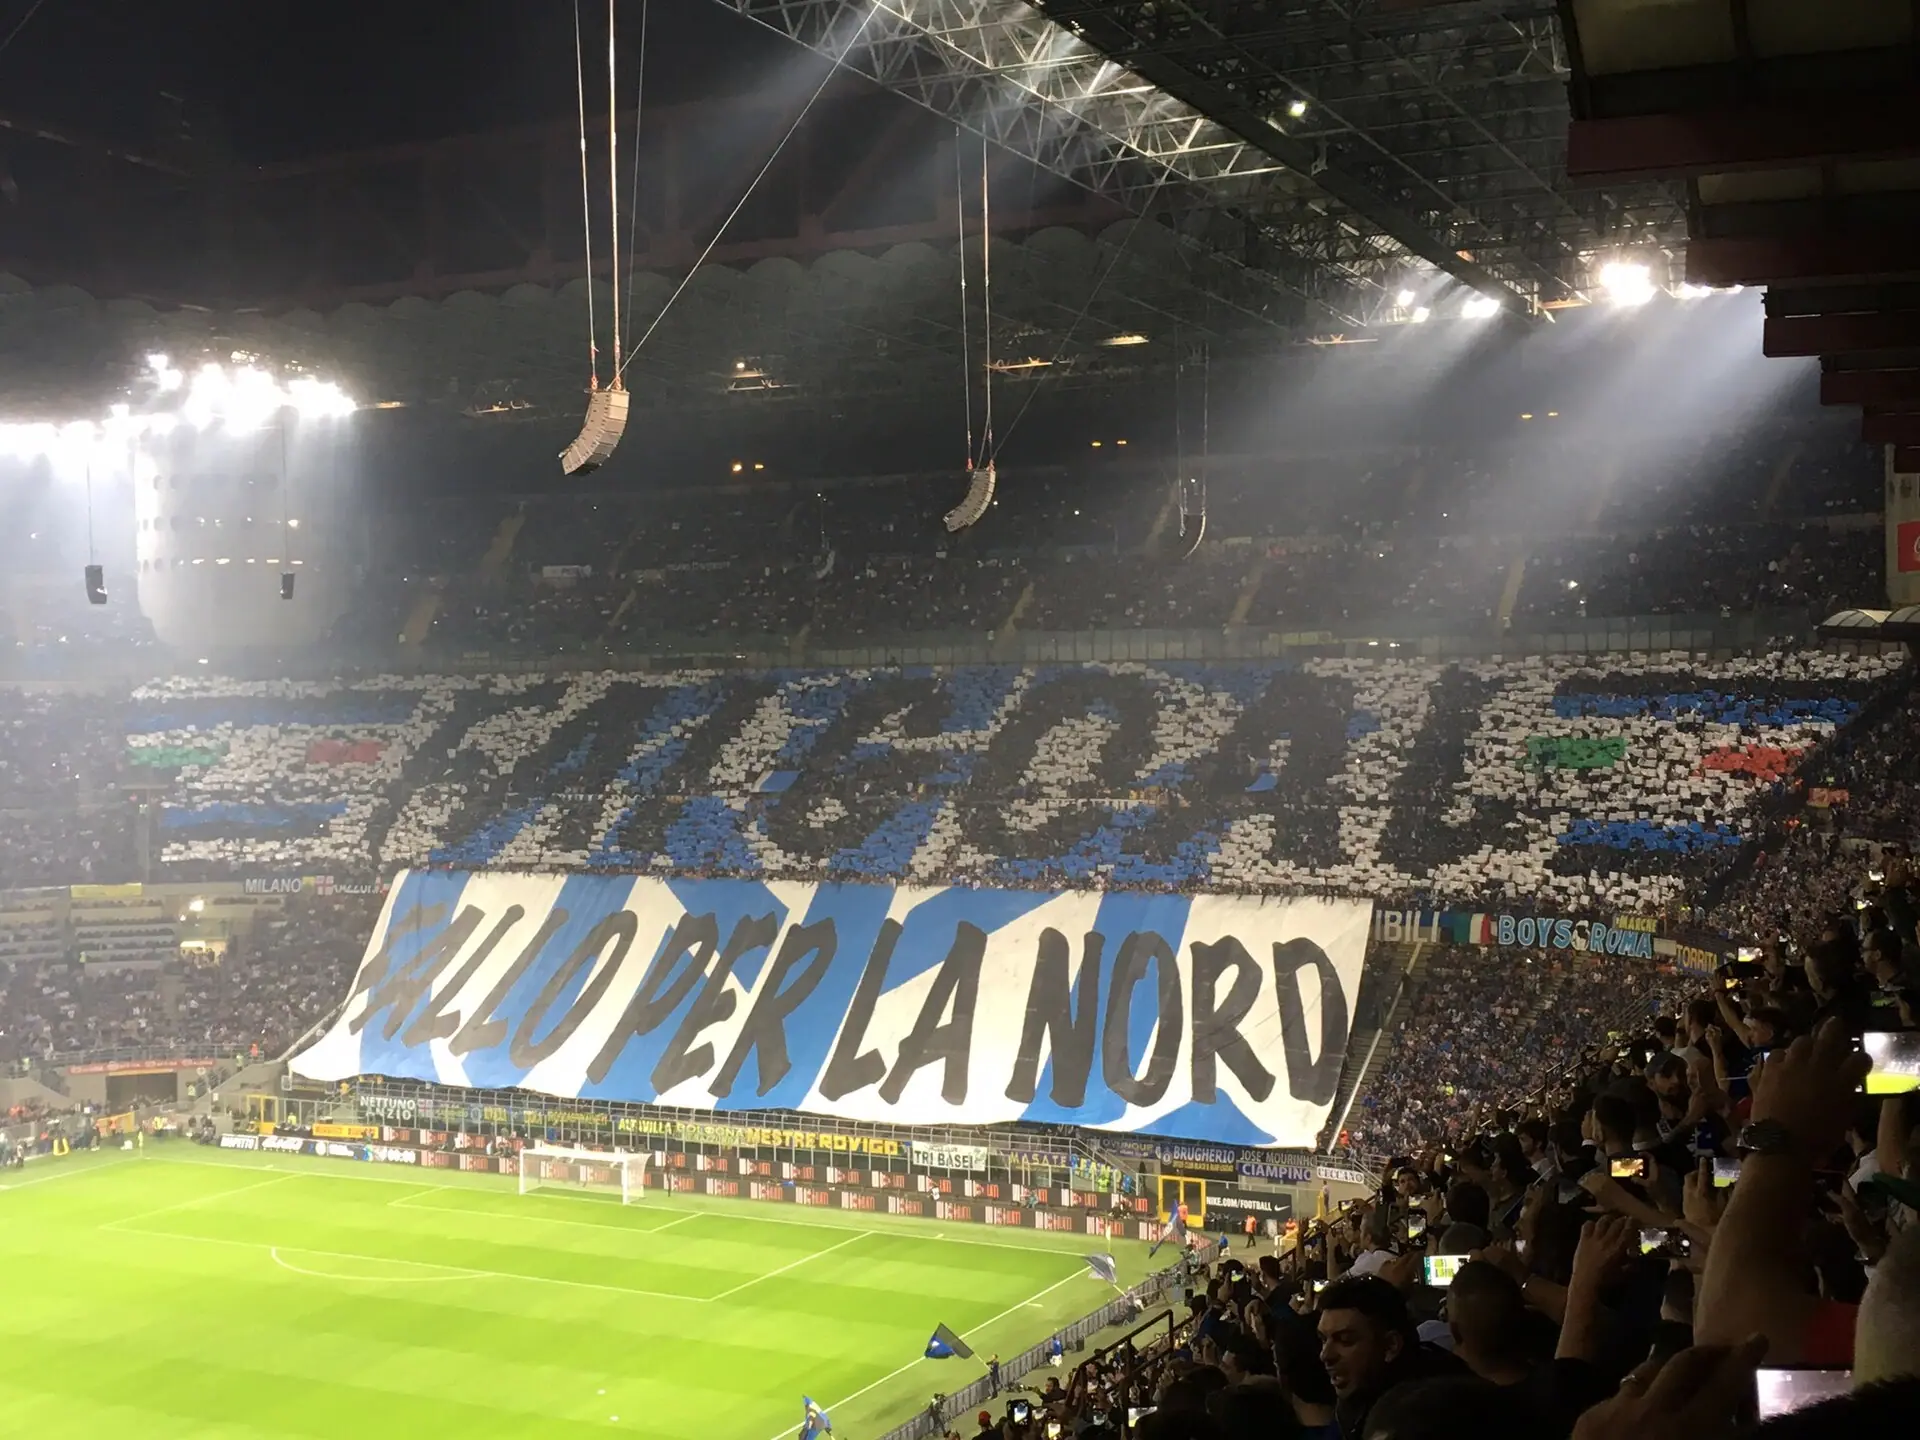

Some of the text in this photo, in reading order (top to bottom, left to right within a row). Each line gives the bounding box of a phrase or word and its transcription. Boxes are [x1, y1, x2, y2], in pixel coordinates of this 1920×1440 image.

[245, 878, 301, 893] MILANO
[1499, 914, 1652, 960] BOYS ROMA
[587, 910, 837, 1098] PER
[819, 916, 988, 1105] LA
[1005, 927, 1348, 1107] NORD
[360, 1095, 416, 1110] NETTUNO
[366, 1108, 412, 1120] ANZIO
[747, 1127, 817, 1148] MESTRE
[818, 1133, 898, 1155] ROVIGO
[914, 1150, 934, 1165] TRI
[1009, 1152, 1067, 1168] MASATE
[1173, 1145, 1236, 1164] BRUGHERIO
[1266, 1152, 1317, 1167] MOURINHO
[1242, 1163, 1313, 1181] CIAMPINO
[1206, 1196, 1273, 1212] NIKE.COM/FOOTBALL
